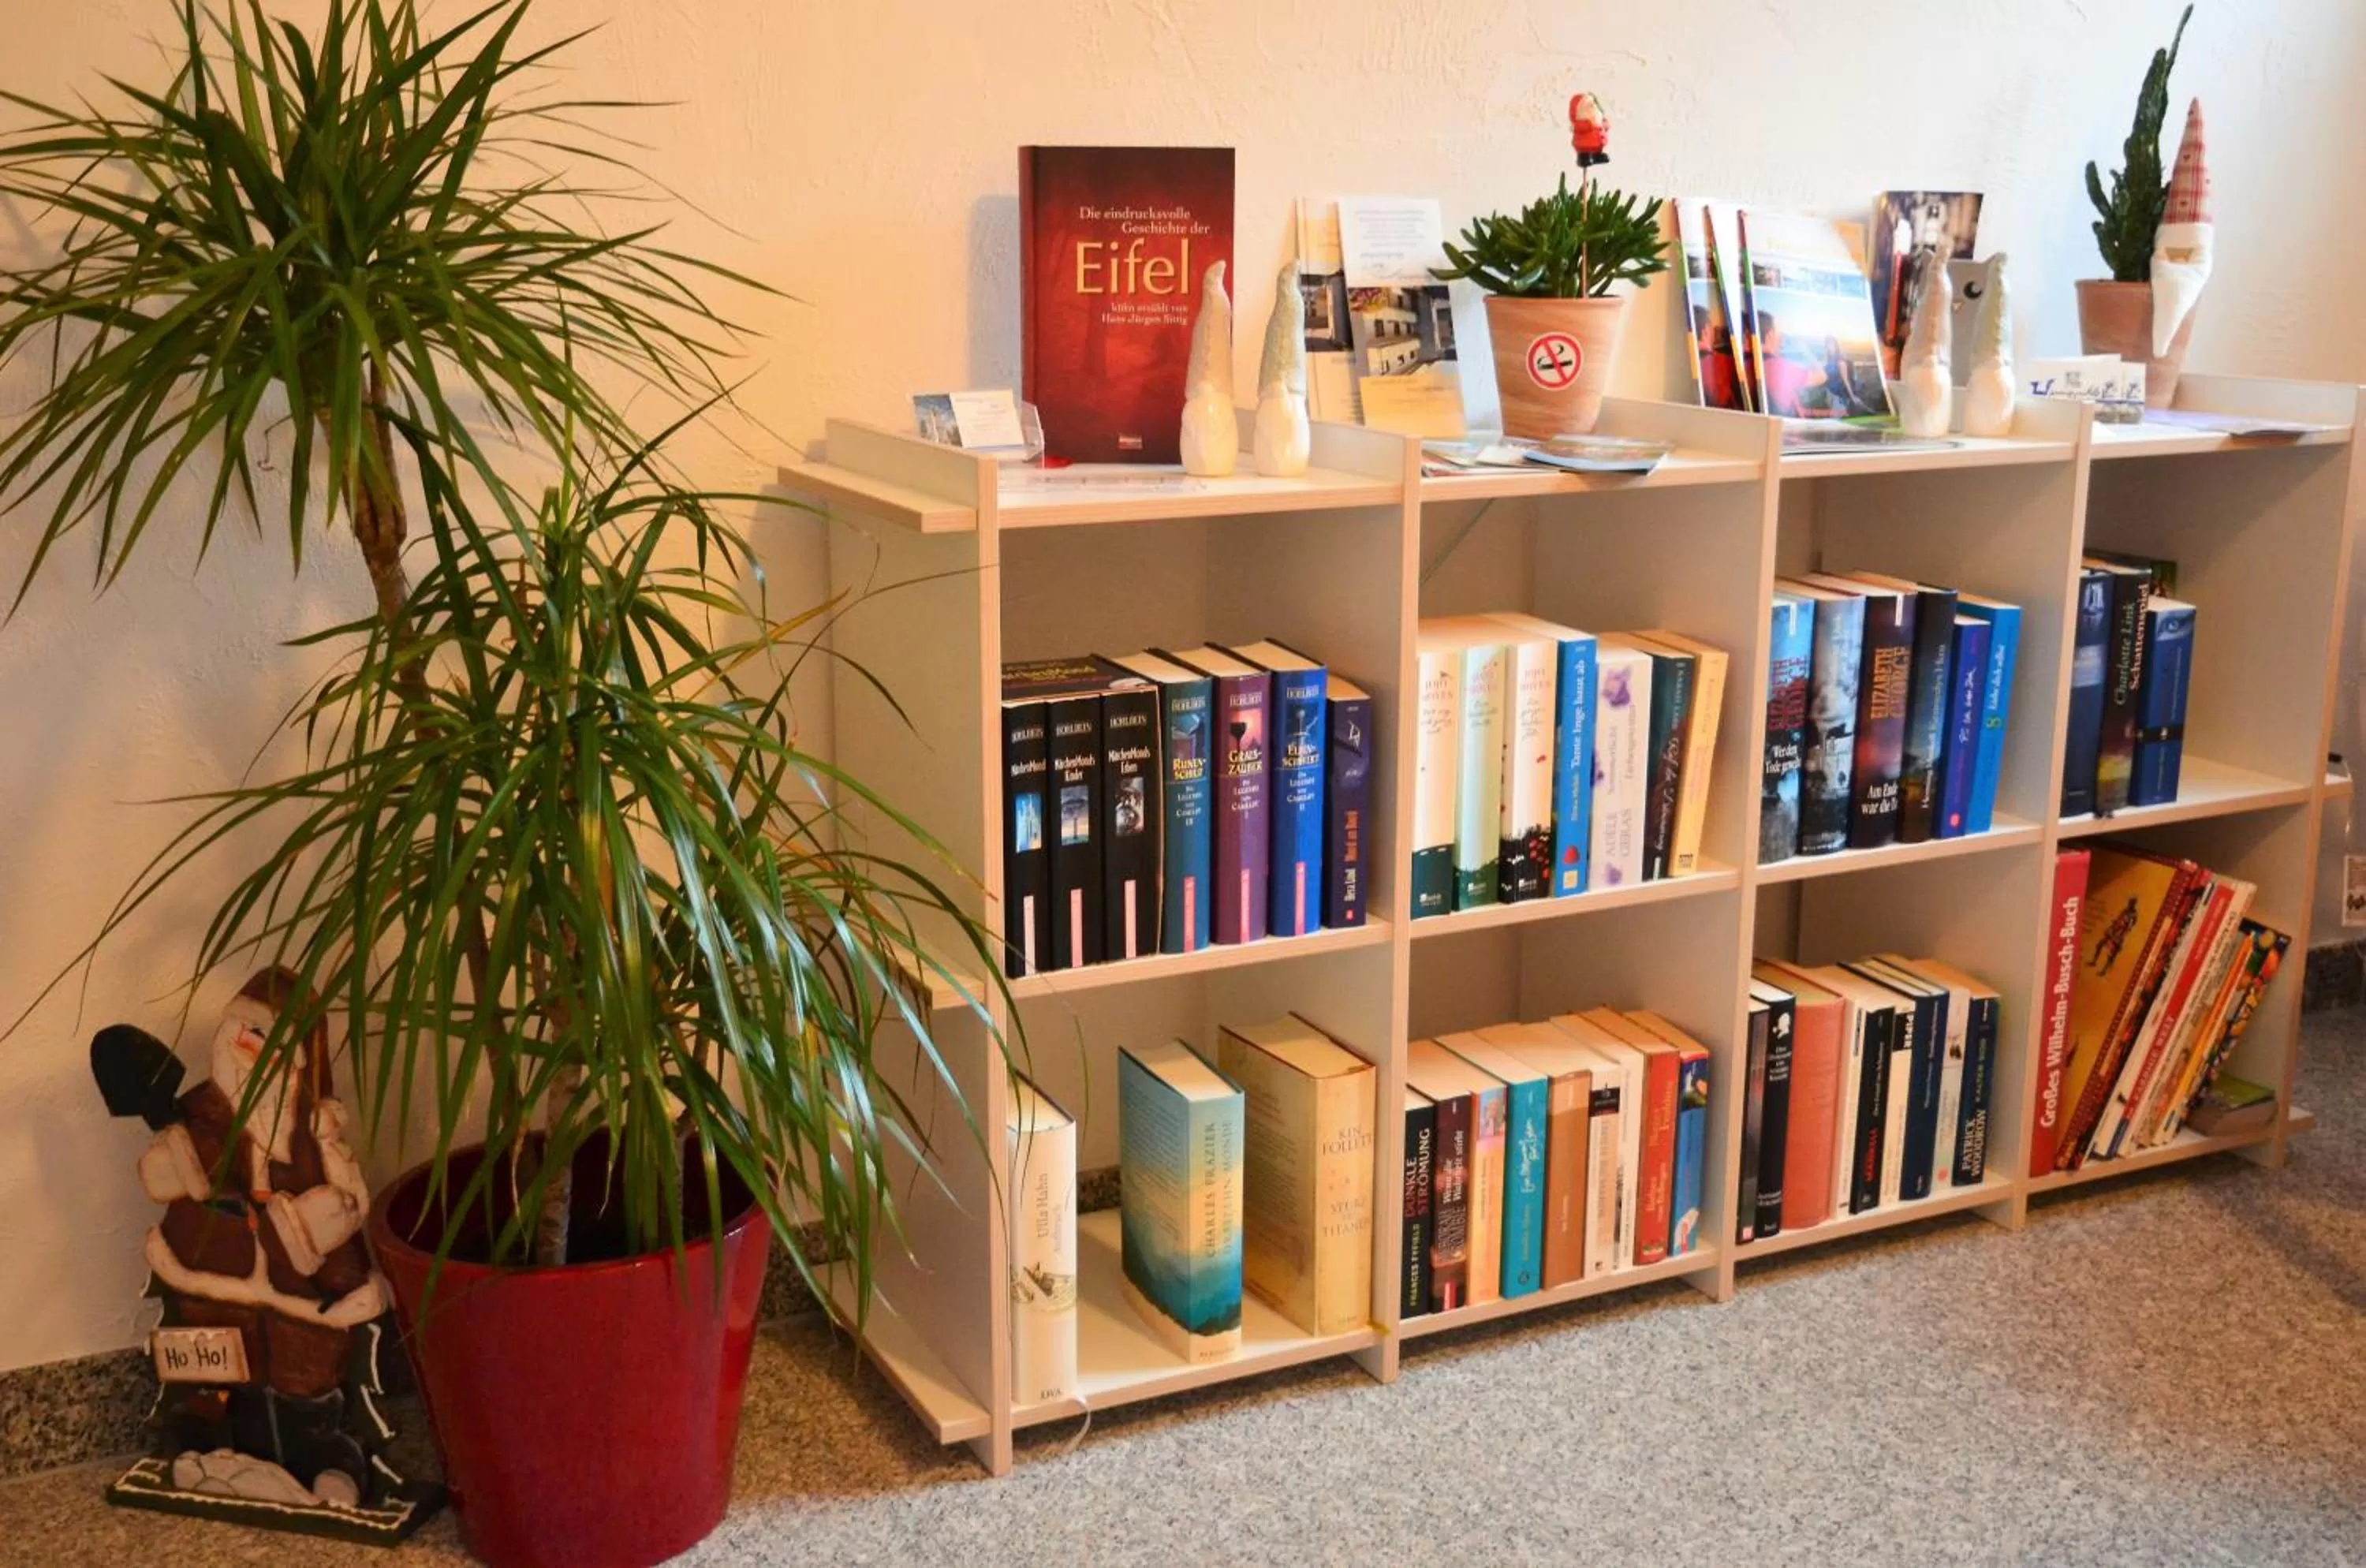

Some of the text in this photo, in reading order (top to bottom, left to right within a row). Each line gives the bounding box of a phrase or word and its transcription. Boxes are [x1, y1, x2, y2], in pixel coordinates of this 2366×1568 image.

[1079, 206, 1191, 221] Die eindrucksvolle
[1121, 220, 1211, 235] Geschichte der
[1076, 237, 1189, 295] Eifel
[2114, 602, 2136, 706] Charlotte Link
[2129, 583, 2149, 691] Schattenspiel
[1871, 647, 1893, 719] ELIZABETH
[2040, 896, 2080, 1128] Großes Wilhelm-Busch-Buch
[1416, 1127, 1431, 1216] STRÖMUNG
[1961, 1118, 1976, 1171] PATRICK
[1034, 1173, 1047, 1208] Hahn
[1204, 1122, 1217, 1259] CHARLES FRAZIER
[1405, 1155, 1418, 1218] DUNKLE
[164, 1345, 228, 1371] Ho Ho!
